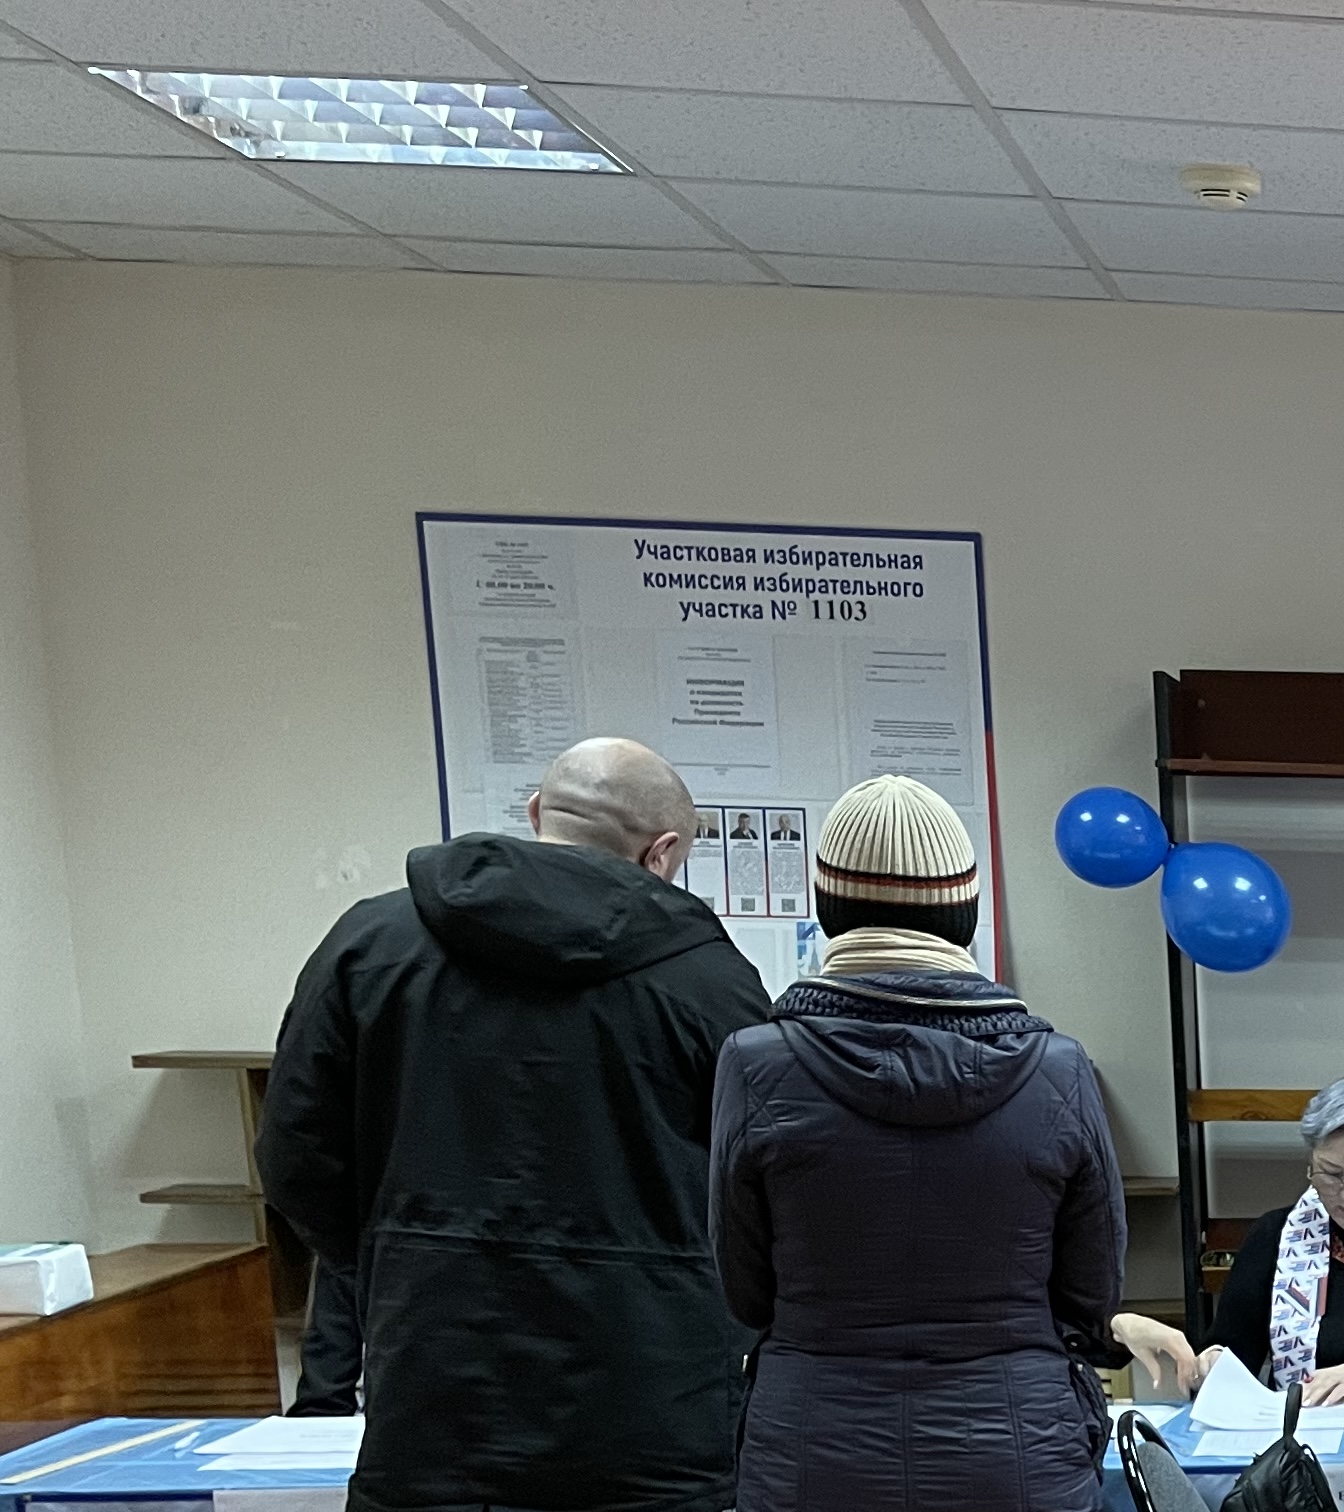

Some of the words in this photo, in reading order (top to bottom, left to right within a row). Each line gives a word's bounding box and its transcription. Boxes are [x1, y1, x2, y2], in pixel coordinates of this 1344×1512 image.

[634, 538, 757, 564] Участковая
[763, 545, 924, 571] избирательная
[643, 570, 746, 592] комиссия
[753, 572, 924, 598] избирательного
[678, 600, 764, 622] участка
[771, 600, 798, 621] №
[811, 600, 868, 622] 1103
